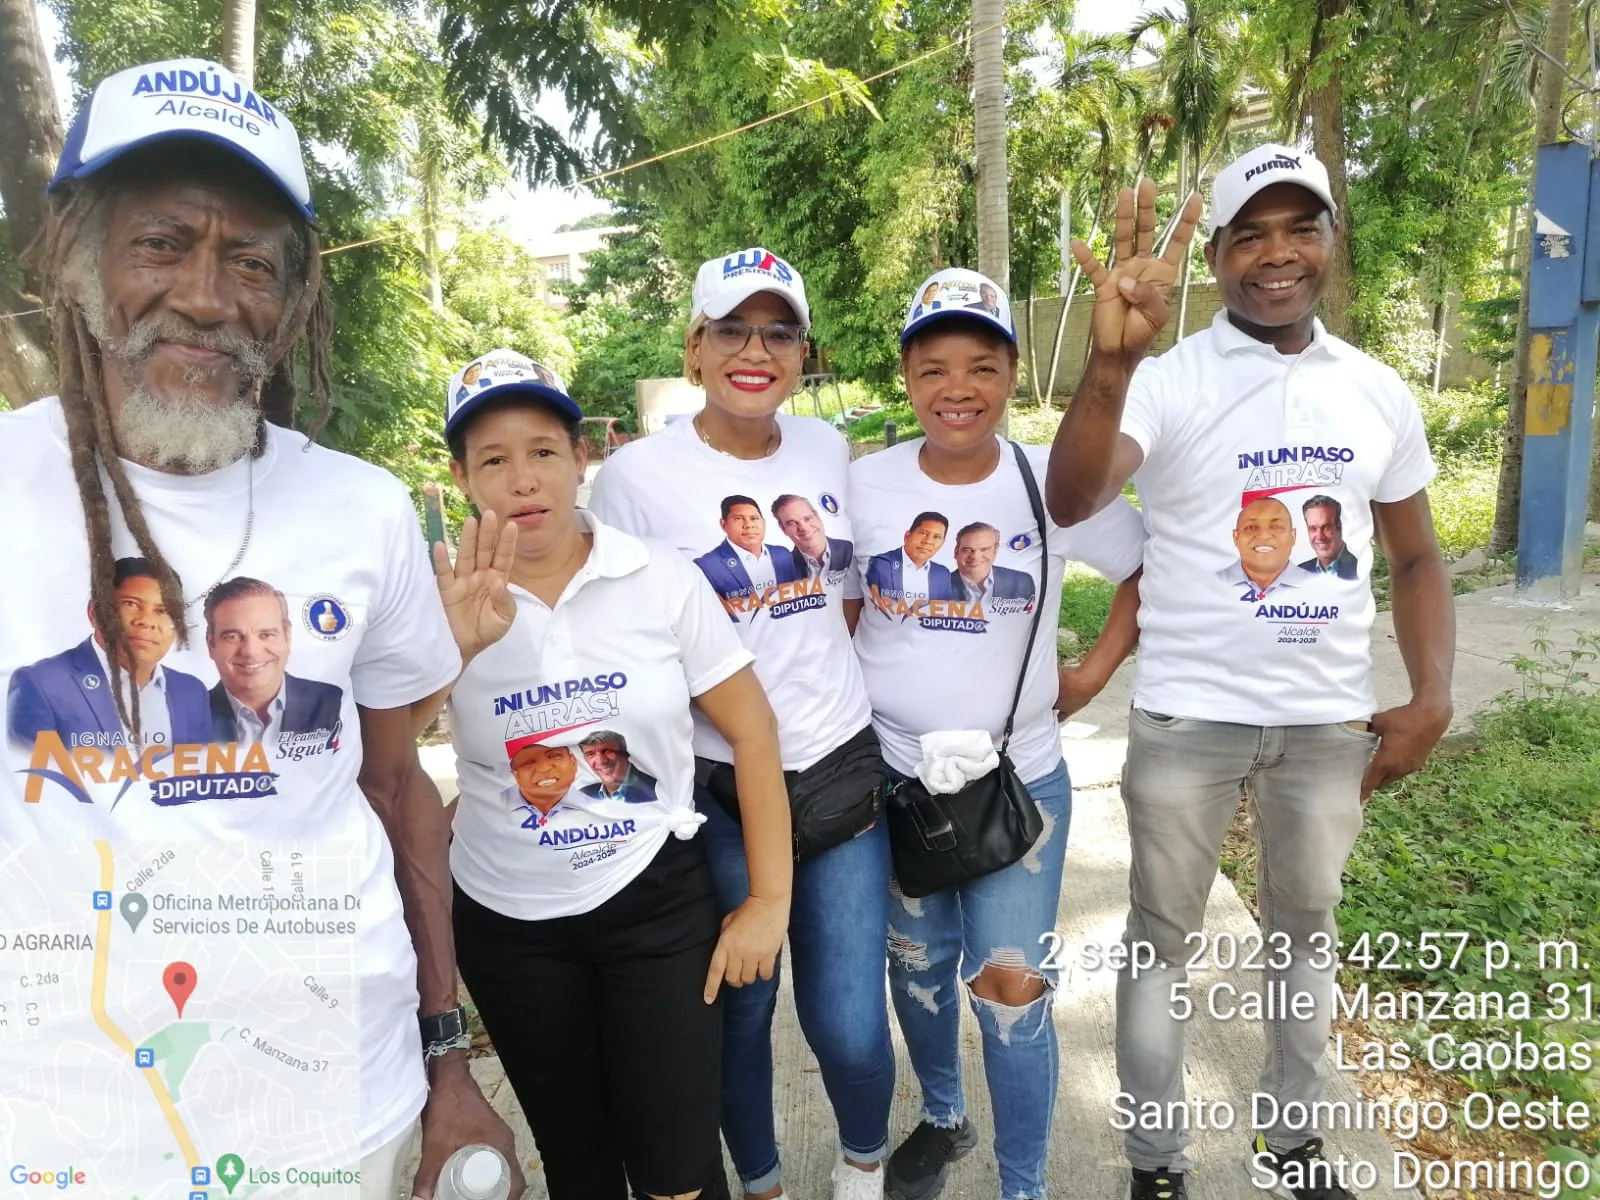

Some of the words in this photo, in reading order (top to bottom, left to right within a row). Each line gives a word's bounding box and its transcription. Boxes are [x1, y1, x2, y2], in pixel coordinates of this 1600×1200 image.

[131, 66, 280, 129] ANDÚJAR
[155, 99, 261, 136] Alcalde
[1267, 447, 1298, 464] UN
[1301, 446, 1354, 463] PASO
[1243, 458, 1344, 491] ATRÁS!
[1255, 602, 1339, 619] ANDÚJAR
[1277, 626, 1320, 636] Alcalde
[526, 683, 562, 706] UN
[564, 672, 628, 699] PASO
[504, 690, 620, 740] ATRÁS!
[275, 738, 325, 761] Sigue
[22, 730, 272, 804] ARACENA
[539, 819, 636, 846] ANDÚJAR
[569, 842, 617, 863] Alcalde
